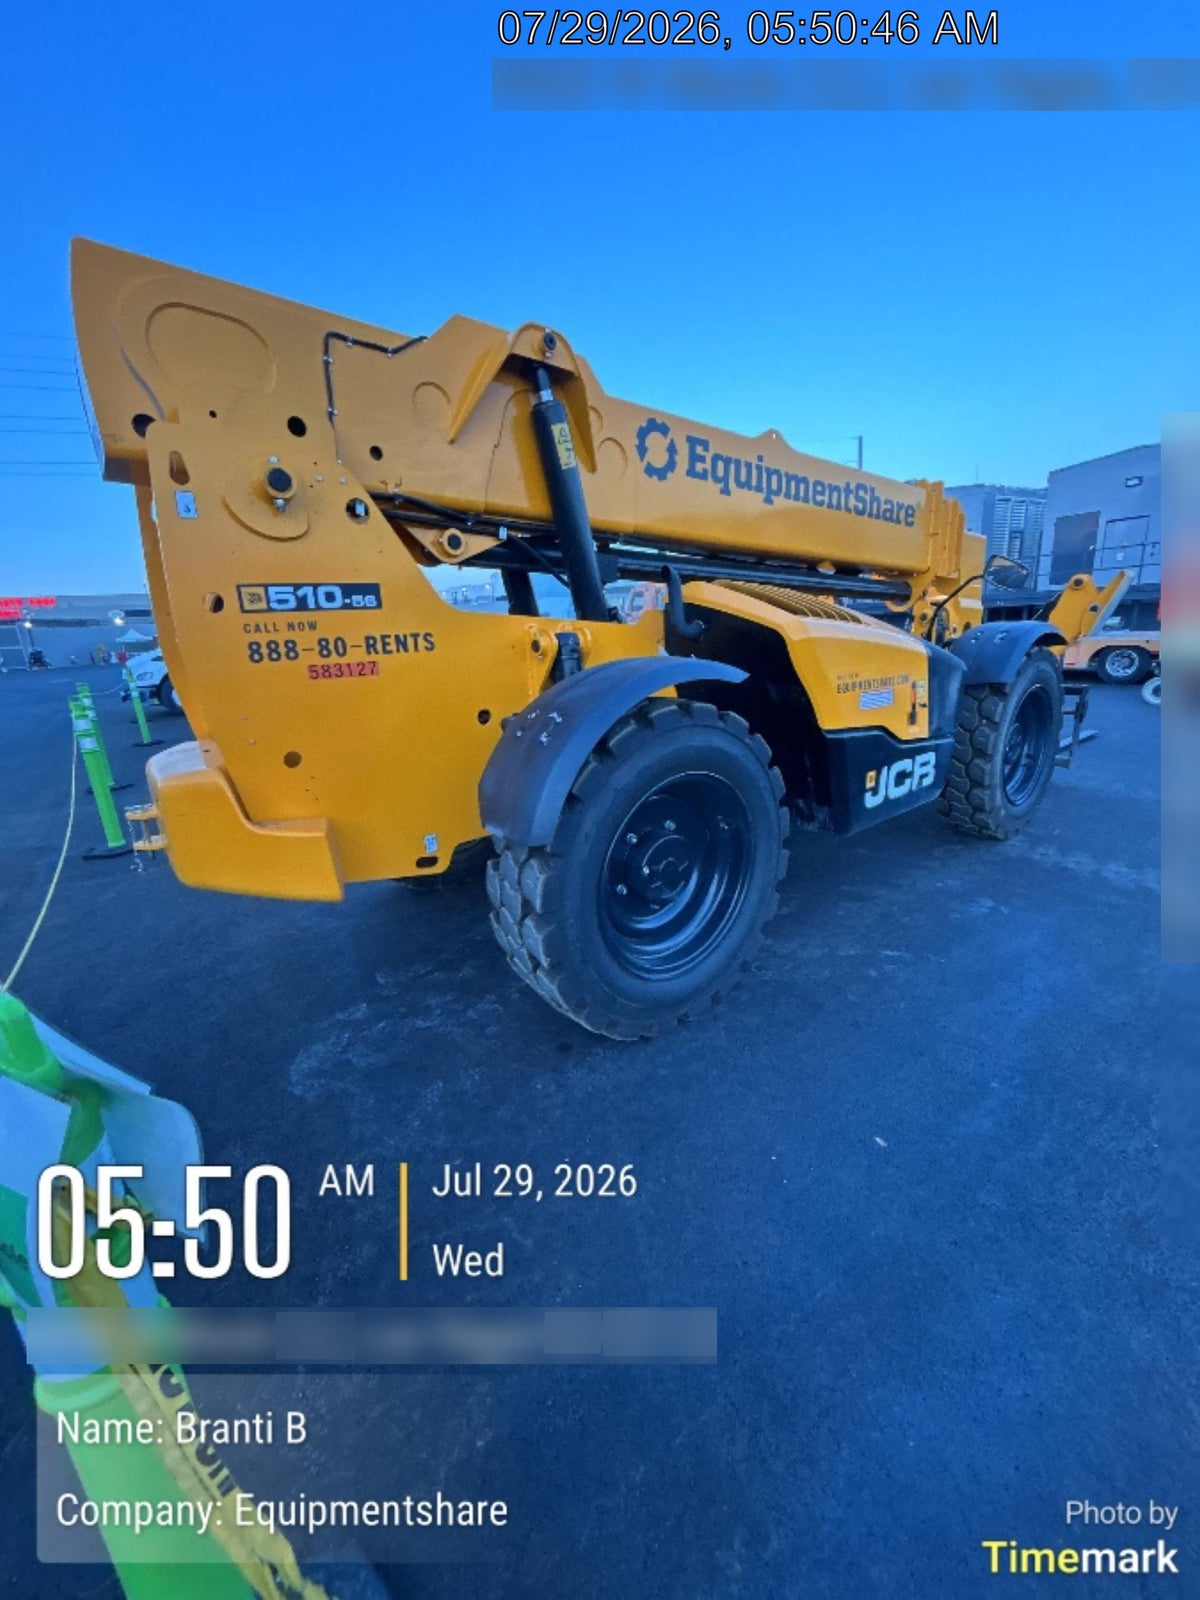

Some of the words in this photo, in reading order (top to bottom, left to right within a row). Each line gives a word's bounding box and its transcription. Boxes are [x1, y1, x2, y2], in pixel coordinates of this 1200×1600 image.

[685, 434, 917, 528] EquipmentShare
[243, 622, 280, 634] CALL
[287, 620, 318, 632] NOW
[247, 632, 436, 664] 888-80-RENTS
[308, 660, 379, 680] 583127
[863, 751, 937, 810] JCB
